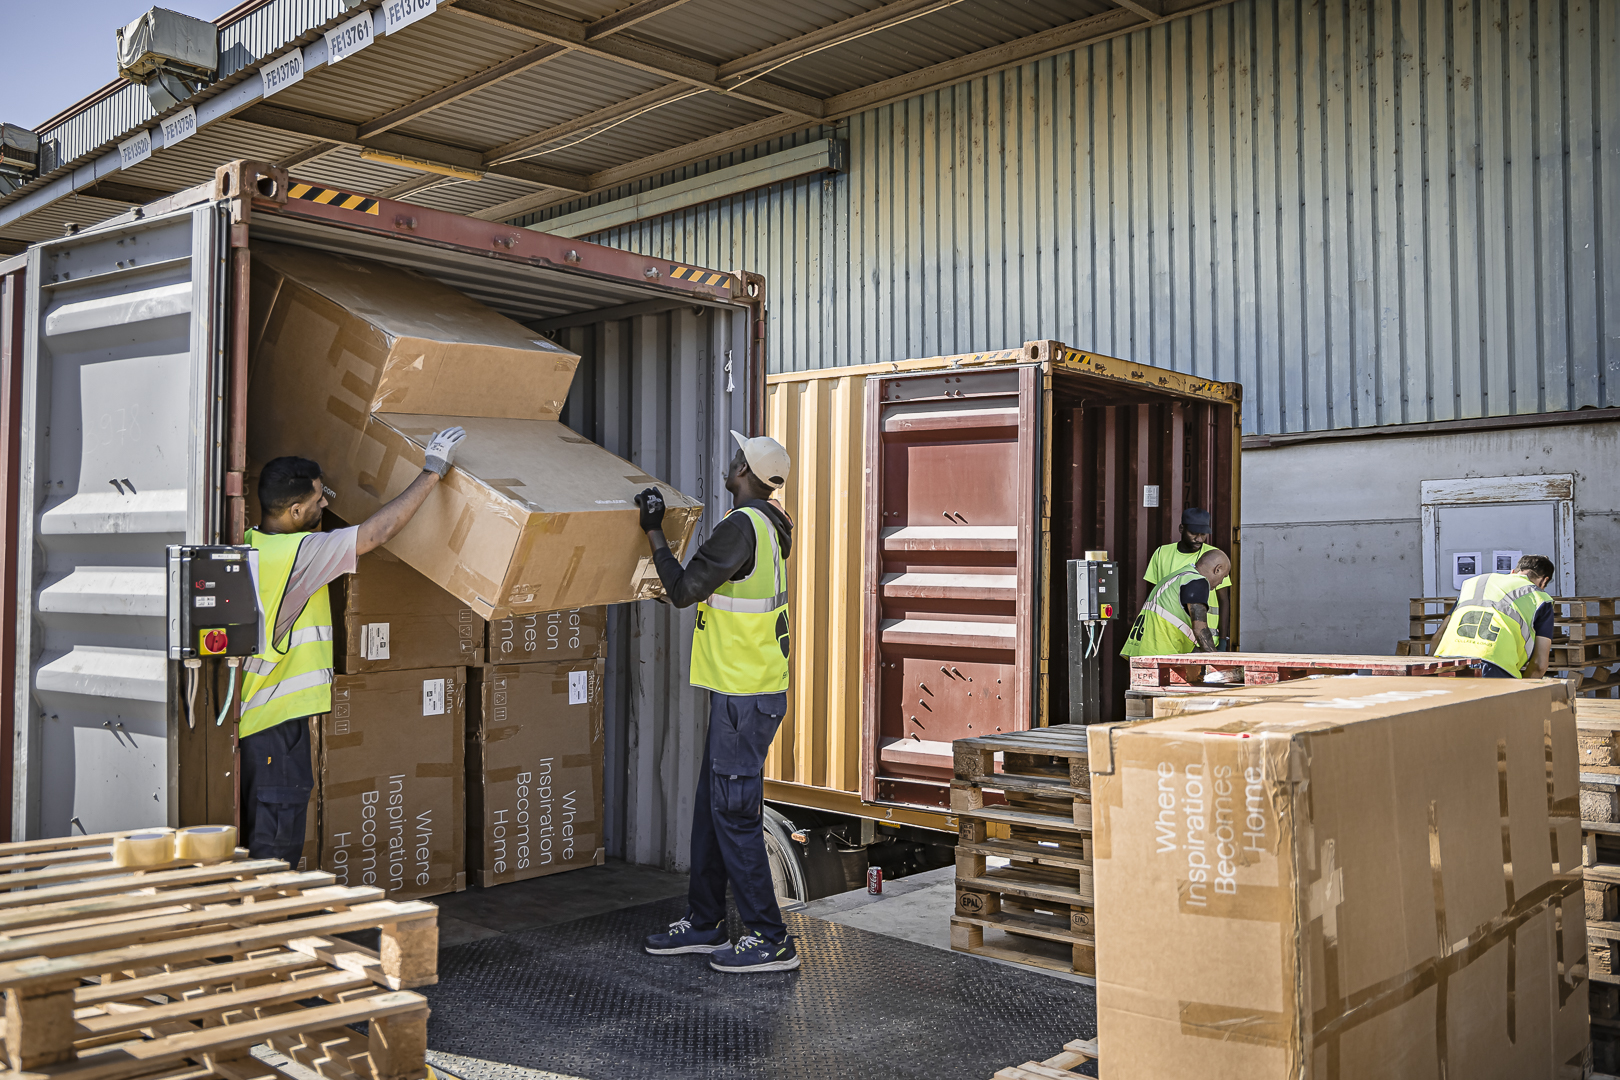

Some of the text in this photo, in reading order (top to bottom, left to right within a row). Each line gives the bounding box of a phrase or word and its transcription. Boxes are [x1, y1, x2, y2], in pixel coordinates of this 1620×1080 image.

[265, 56, 300, 89] FE13760
[330, 19, 370, 56] FE13761
[122, 137, 149, 163] FE13520
[165, 113, 194, 141] FE13756
[446, 678, 455, 710] sklum
[362, 790, 379, 885] Become
[386, 773, 407, 892] Inspiration
[493, 809, 508, 874] Home
[516, 771, 532, 869] Becomes
[537, 757, 554, 865] Inspiration
[562, 789, 576, 860] Where
[1154, 760, 1177, 855] Where
[1182, 762, 1210, 908] Inspiration
[1213, 764, 1237, 896] Becomes
[1242, 765, 1266, 853] Home
[333, 831, 352, 886] Hom
[416, 809, 432, 886] Where
[962, 896, 980, 909] EPAL
